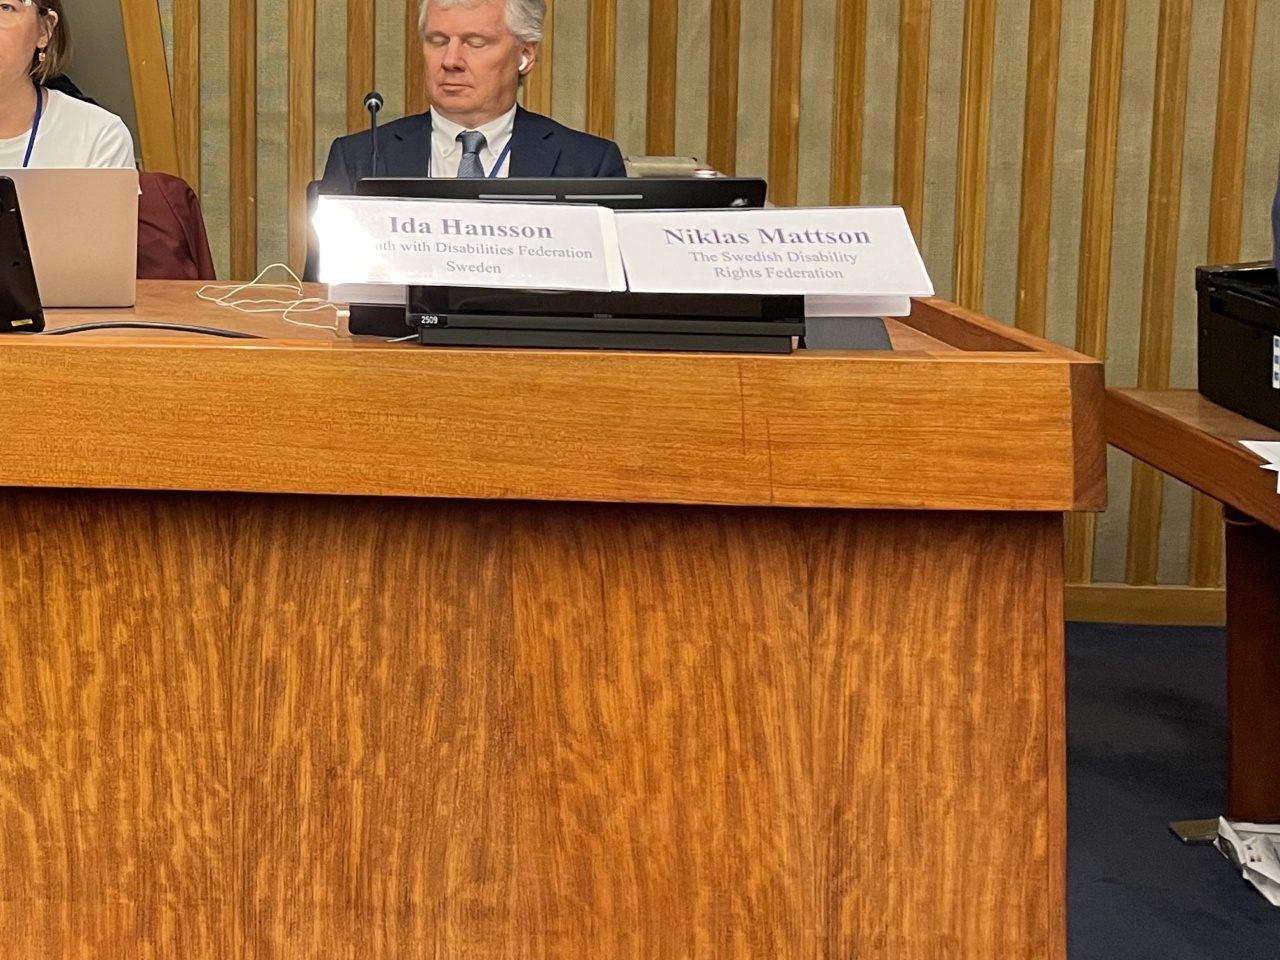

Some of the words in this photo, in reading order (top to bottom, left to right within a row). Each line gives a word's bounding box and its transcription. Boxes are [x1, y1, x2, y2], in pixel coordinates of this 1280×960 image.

[390, 216, 432, 235] Ida
[441, 218, 554, 240] Hansson
[663, 228, 750, 246] Niklas
[757, 227, 873, 246] Mattson
[401, 242, 431, 253] with
[436, 242, 515, 257] Disabilities
[519, 245, 594, 260] Federation
[689, 251, 719, 263] The
[722, 251, 783, 263] Swedish
[787, 251, 858, 265] Disability
[446, 260, 502, 275] Sweden
[714, 266, 763, 281] Rights
[767, 267, 844, 280] Federation
[421, 315, 438, 325] 2509
